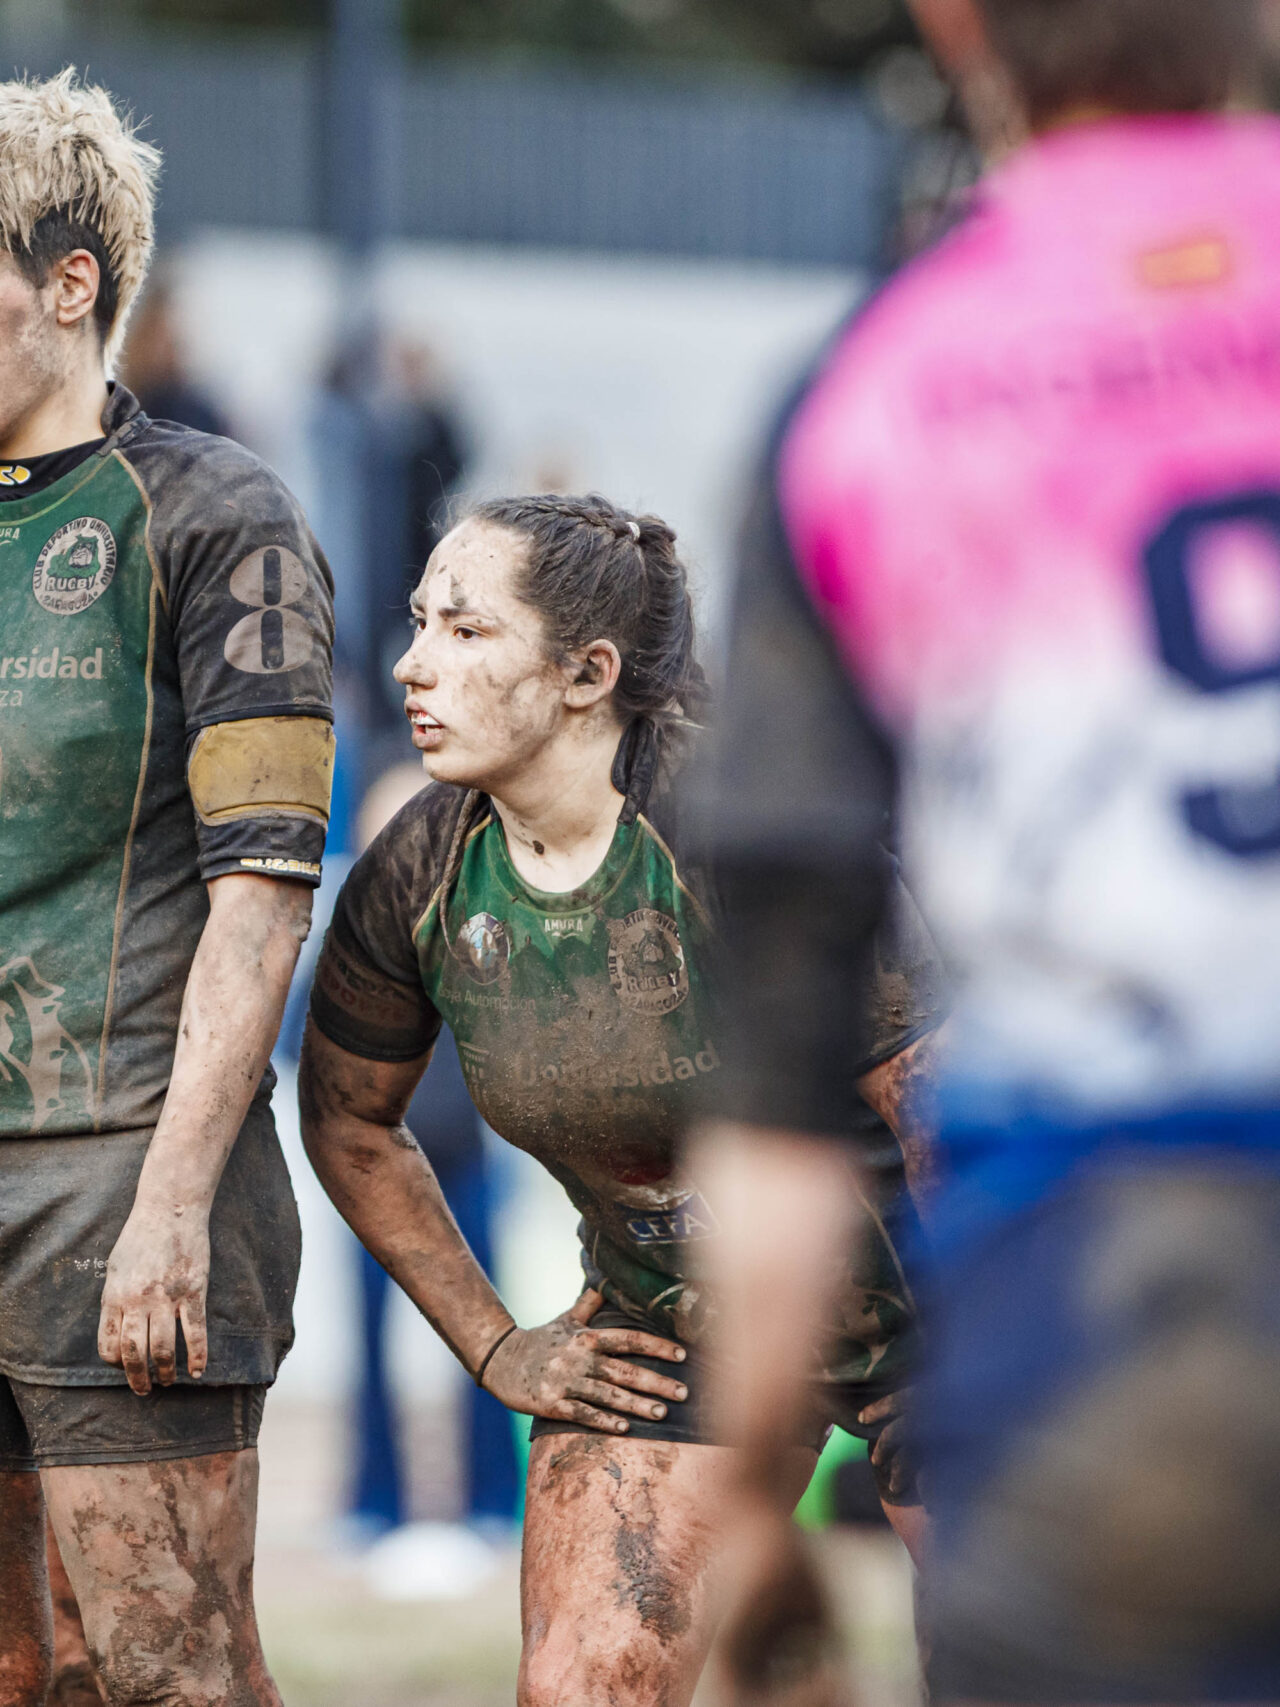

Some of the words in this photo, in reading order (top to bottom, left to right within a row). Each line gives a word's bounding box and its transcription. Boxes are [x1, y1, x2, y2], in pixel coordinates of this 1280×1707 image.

[41, 518, 88, 557] DEPORTIVO
[45, 573, 96, 592] RUGBY
[223, 544, 315, 674] 8
[544, 918, 584, 932] AMURA
[626, 1212, 711, 1238] CEFA
